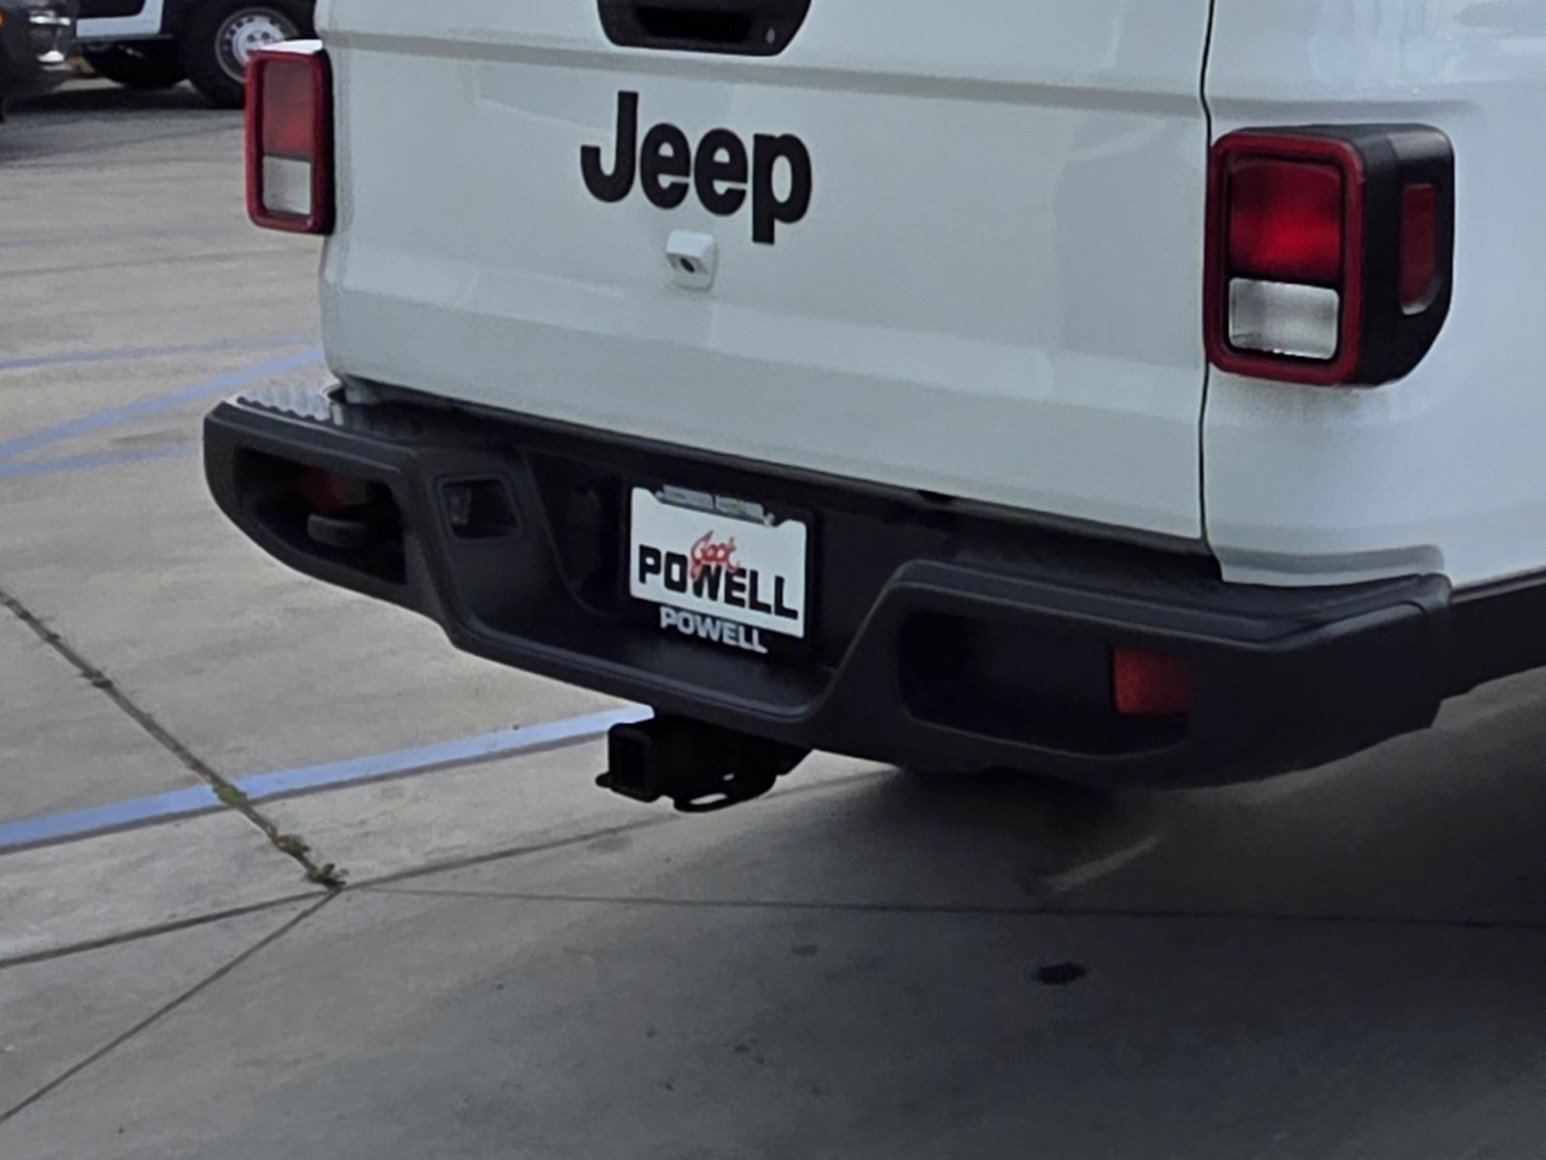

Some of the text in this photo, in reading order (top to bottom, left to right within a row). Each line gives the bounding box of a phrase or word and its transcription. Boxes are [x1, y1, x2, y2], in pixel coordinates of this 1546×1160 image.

[580, 90, 812, 245] Jeep
[638, 543, 798, 620] POWELL
[660, 605, 768, 654] POWELL
